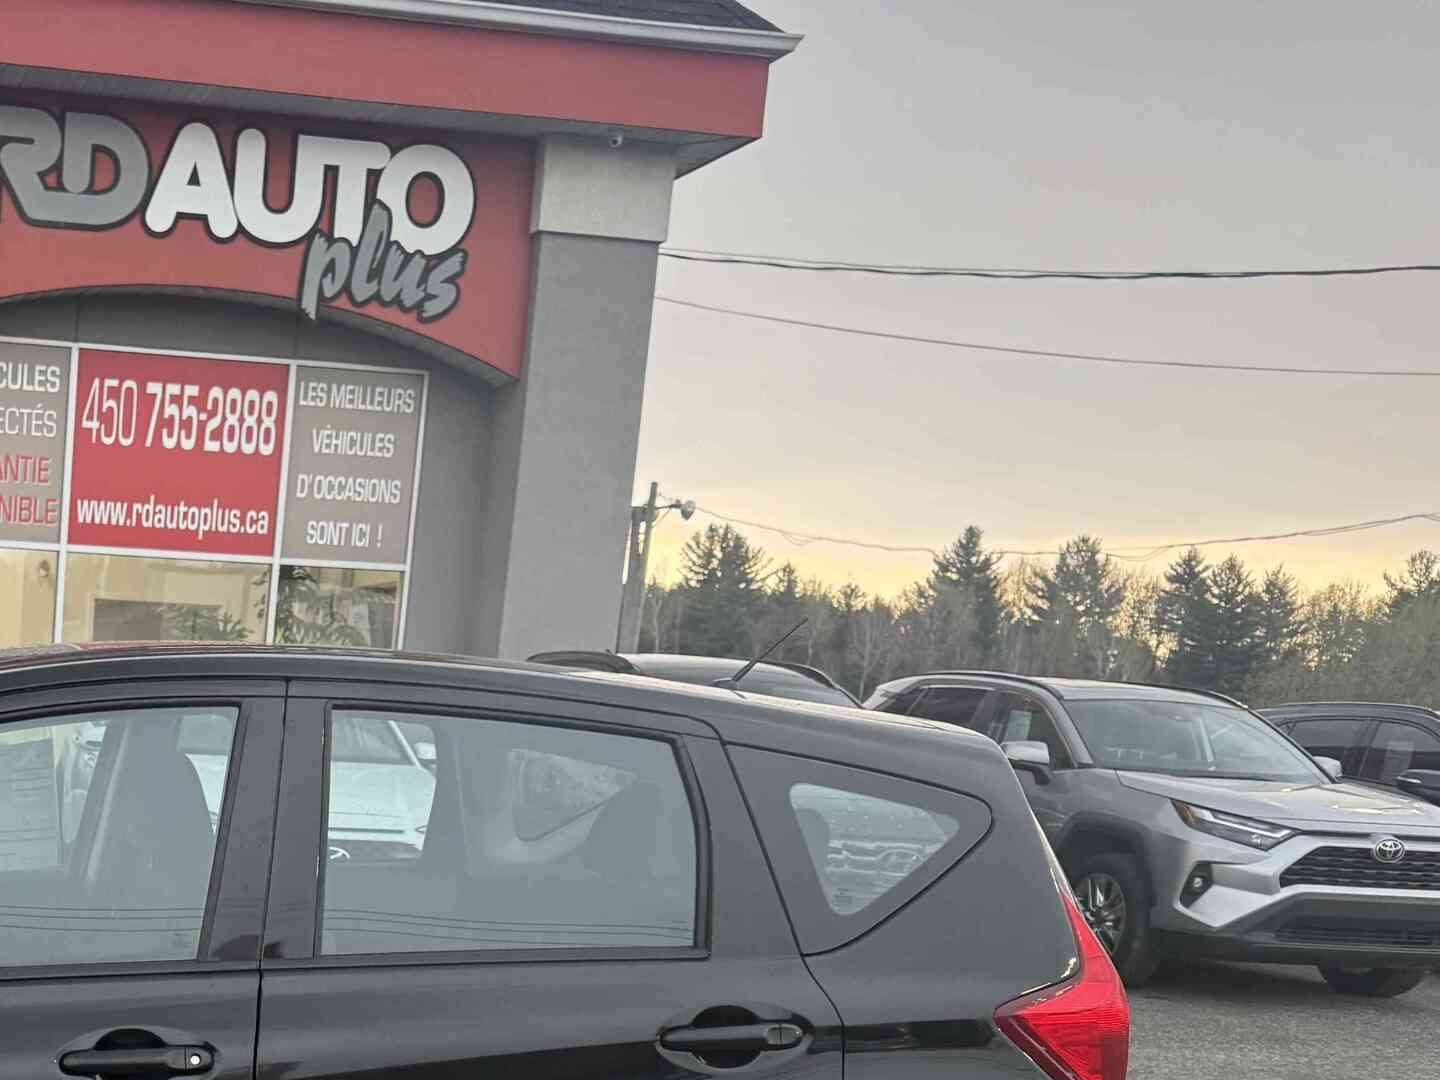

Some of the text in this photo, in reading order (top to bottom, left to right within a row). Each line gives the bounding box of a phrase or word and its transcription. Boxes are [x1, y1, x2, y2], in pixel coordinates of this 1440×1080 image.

[300, 199, 466, 322] plus
[81, 377, 279, 456] 450 755-2888
[299, 381, 415, 414] LES MEILLEURS
[312, 424, 395, 458] VÉHICULES
[76, 493, 270, 541] www.rdautoplus.ca
[306, 520, 350, 546] SONT
[350, 523, 371, 548] ICI
